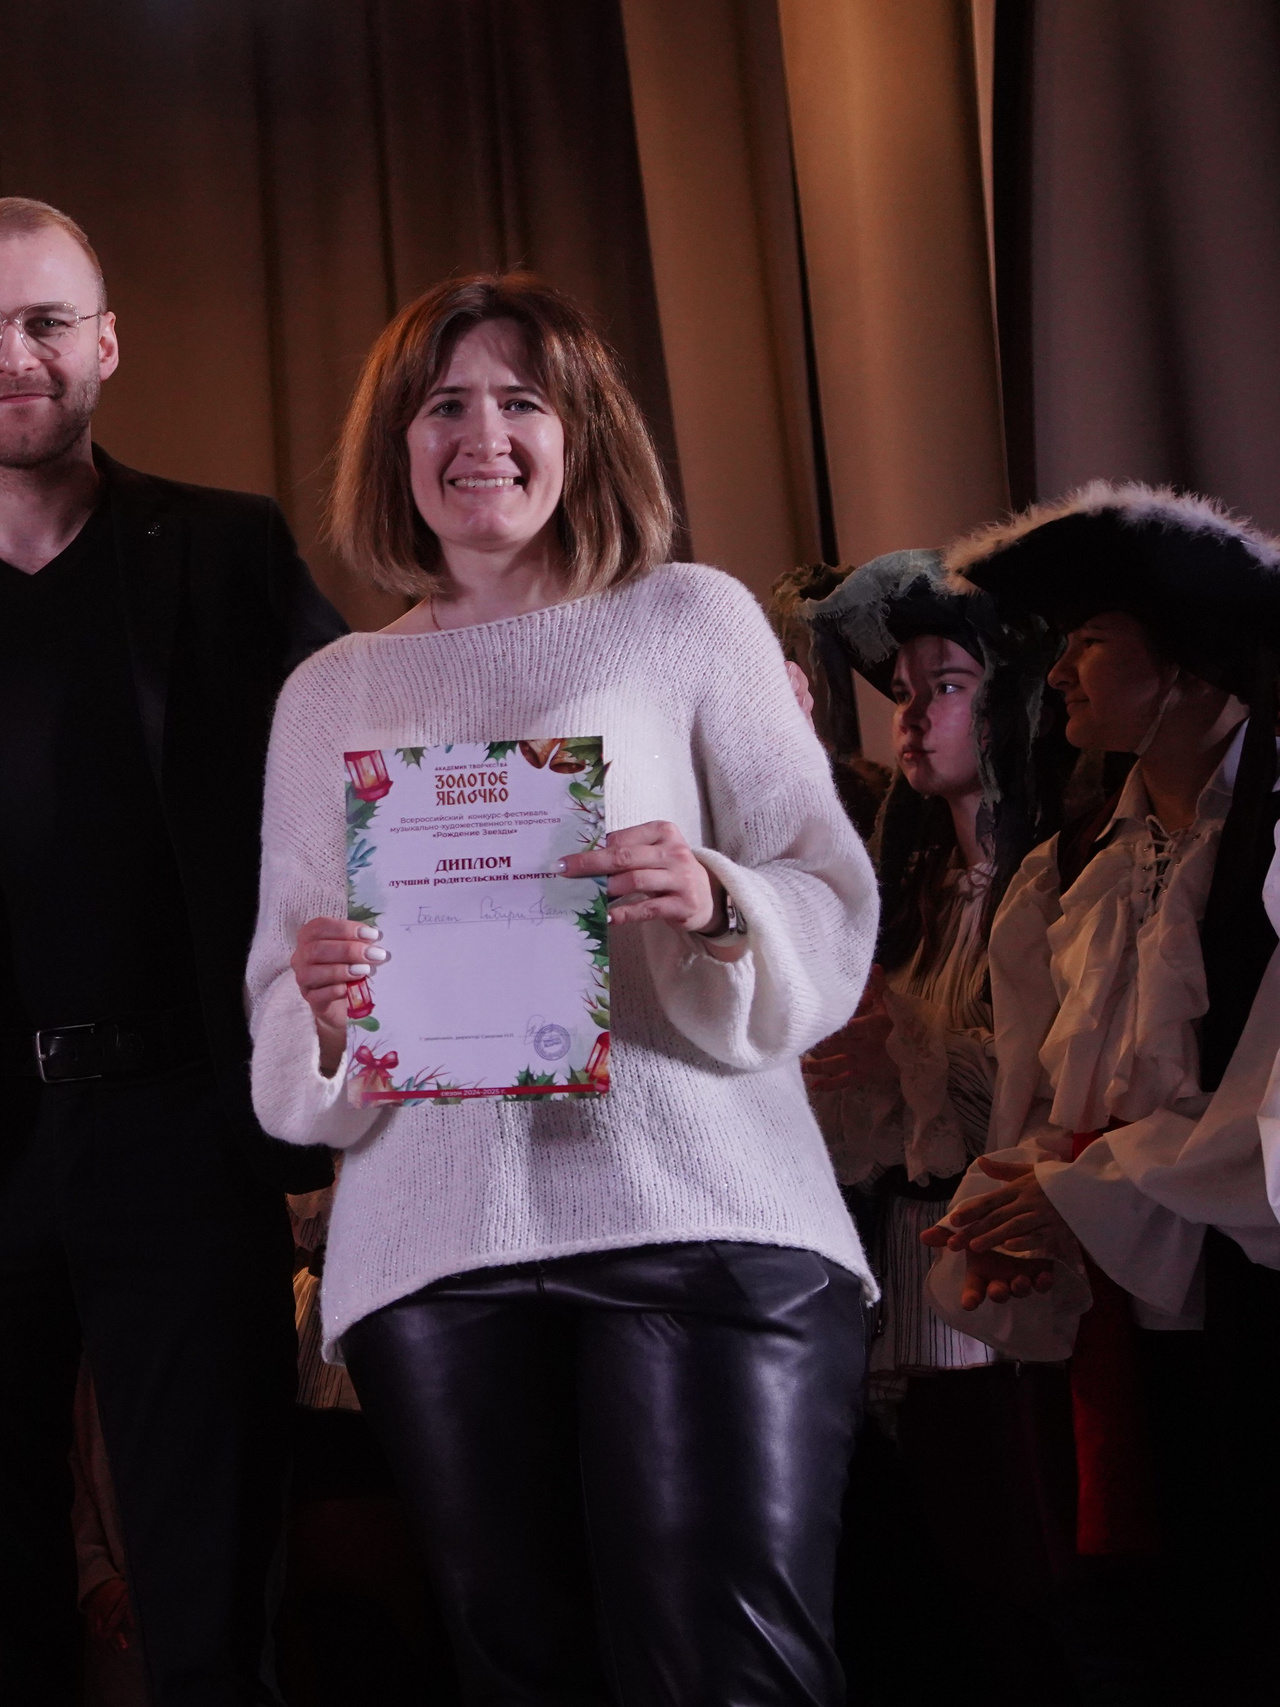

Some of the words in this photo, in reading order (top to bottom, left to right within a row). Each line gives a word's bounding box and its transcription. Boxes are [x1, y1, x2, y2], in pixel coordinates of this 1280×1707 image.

[435, 764, 468, 772] АКАДЕМИЯ
[435, 771, 508, 789] ЗОЛОТОЕ
[436, 787, 509, 806] ЯБЛОЧКО
[400, 813, 464, 824] Всероссийский
[468, 809, 549, 821] конкурс-фестиваль
[390, 820, 512, 833] музыкально-художественного
[514, 817, 561, 827] творчества
[435, 856, 512, 874] ДИПЛОМ
[388, 877, 430, 889] лучший
[433, 873, 509, 887] родительский
